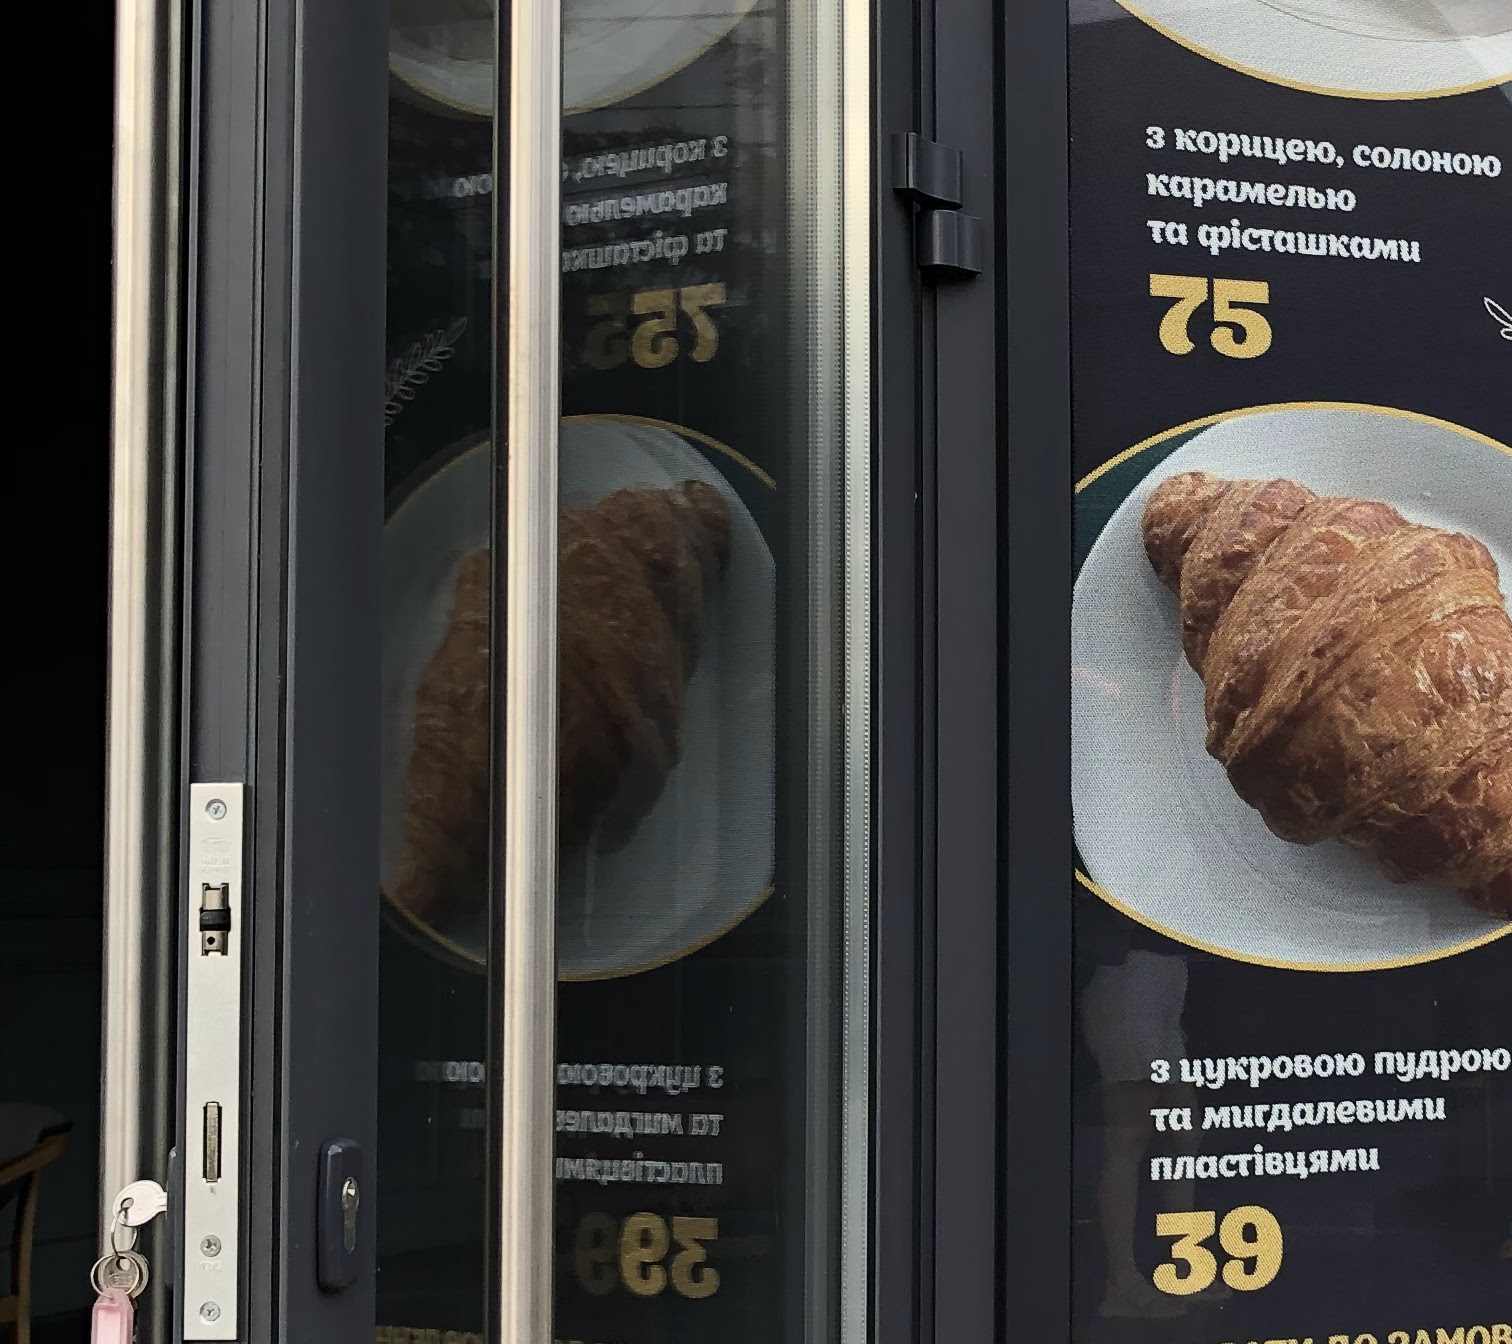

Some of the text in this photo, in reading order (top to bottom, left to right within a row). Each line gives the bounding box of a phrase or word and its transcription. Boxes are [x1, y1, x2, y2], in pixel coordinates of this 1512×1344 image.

[1146, 126, 1502, 178] з корицею, солоною
[1146, 172, 1356, 213] карамелью
[1146, 218, 1421, 263] та фісташками
[1149, 273, 1273, 359] 75
[1150, 1047, 1512, 1089] з цукровою пудрою
[1150, 1094, 1446, 1133] та мигдалевими
[1150, 1144, 1380, 1181] пластівцями
[1152, 1205, 1284, 1295] 39
